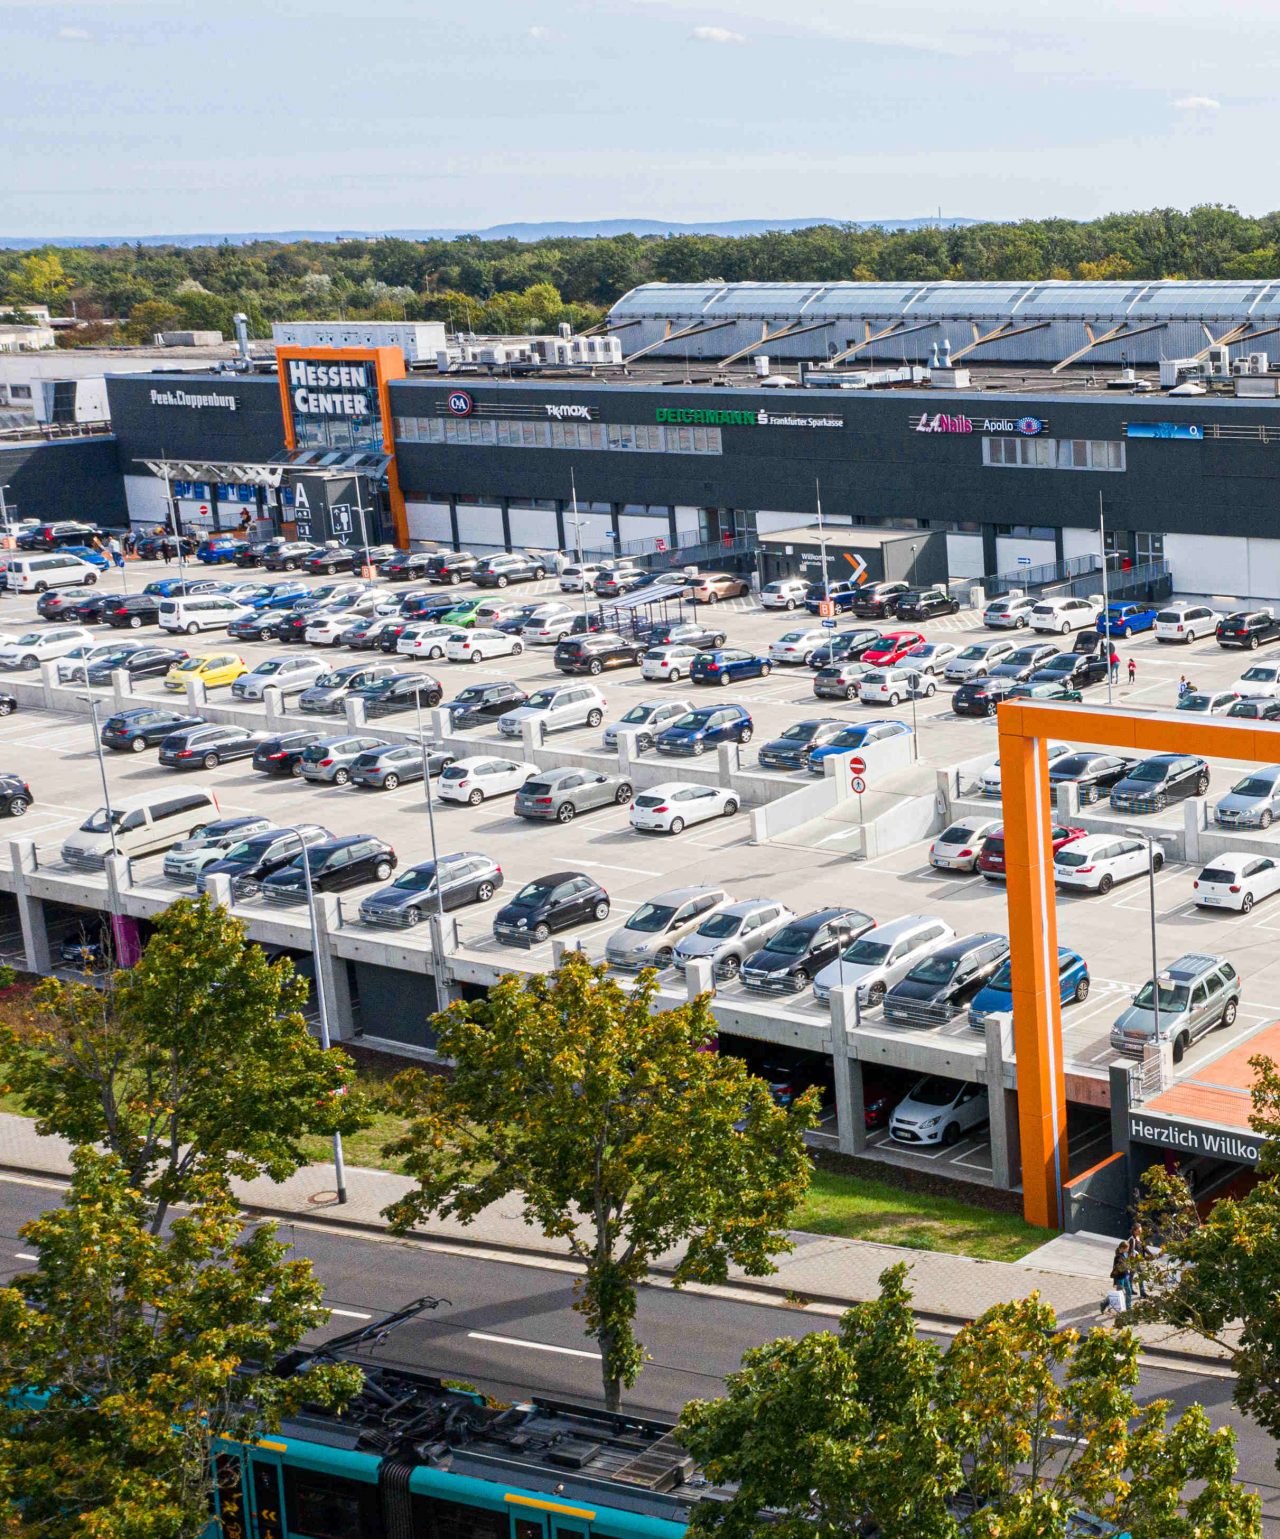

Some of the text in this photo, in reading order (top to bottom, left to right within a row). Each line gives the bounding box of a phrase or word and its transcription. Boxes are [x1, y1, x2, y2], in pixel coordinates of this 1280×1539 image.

[289, 361, 367, 387] HESSEN
[294, 389, 369, 414] CENTER
[656, 408, 755, 425] DEICHMANN
[770, 417, 807, 426] Frankfurter
[808, 418, 843, 428] Sparkasse
[941, 415, 973, 432] Nails
[983, 419, 1014, 432] Apollo
[295, 483, 309, 507] A
[1131, 1119, 1198, 1148] Herzlich
